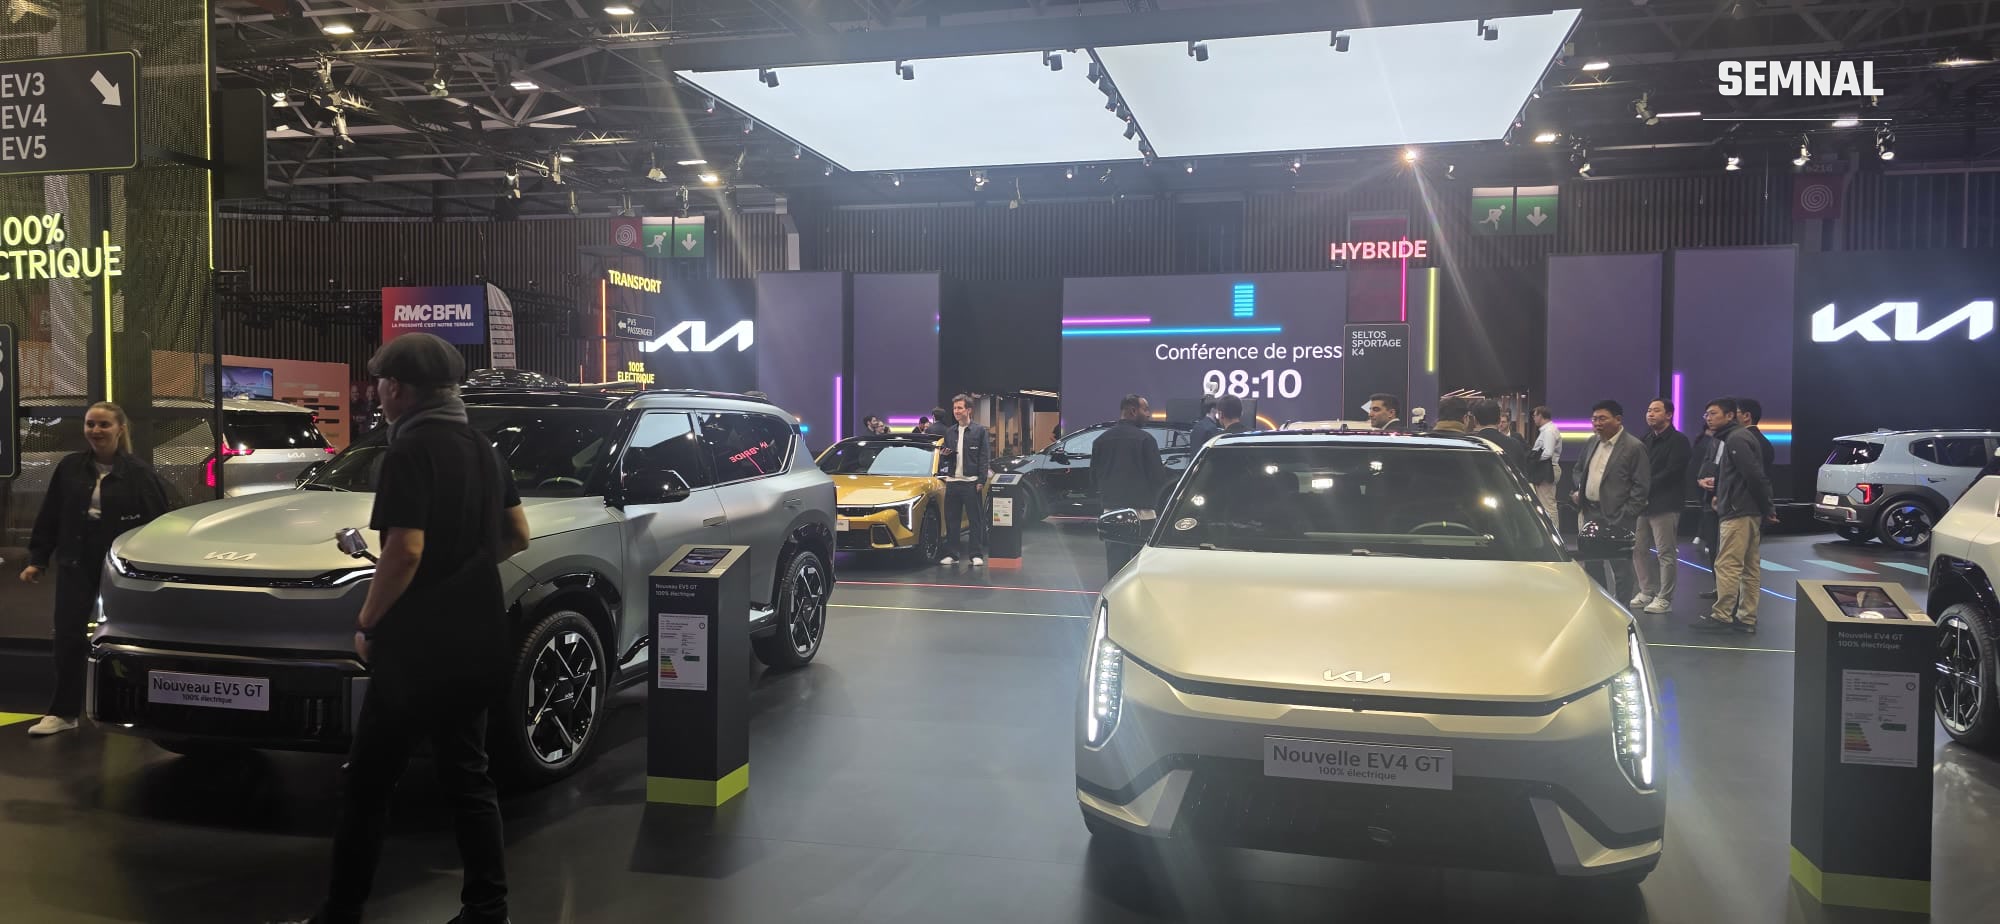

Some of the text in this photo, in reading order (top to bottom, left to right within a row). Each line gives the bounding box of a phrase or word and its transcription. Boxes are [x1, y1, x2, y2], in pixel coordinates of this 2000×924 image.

[1, 72, 45, 98] EV3
[1, 104, 47, 129] EV4
[2, 135, 47, 160] EV5
[0, 212, 65, 246] 00%
[1330, 240, 1427, 261] HYBRIDE
[608, 269, 662, 294] TRANSPORT
[1811, 300, 1994, 342] KIA
[638, 321, 754, 352] KIA
[1352, 330, 1387, 339] SELTOS
[1352, 339, 1401, 348] SPORTAGE
[1155, 344, 1258, 360] Conférence
[1264, 343, 1287, 360] de
[1352, 348, 1365, 356] K4
[628, 361, 645, 373] 100%
[1203, 369, 1302, 399] 08:10
[203, 551, 257, 561] KIA
[1838, 640, 1860, 648] 100%
[1874, 632, 1890, 640] EV4
[1892, 633, 1904, 641] GT
[1323, 669, 1391, 684] KIA
[153, 678, 264, 697] Nouveau EV5 GT
[1273, 745, 1445, 772] Nouvelle EV4 GT
[1318, 766, 1397, 780] 100% électrique
